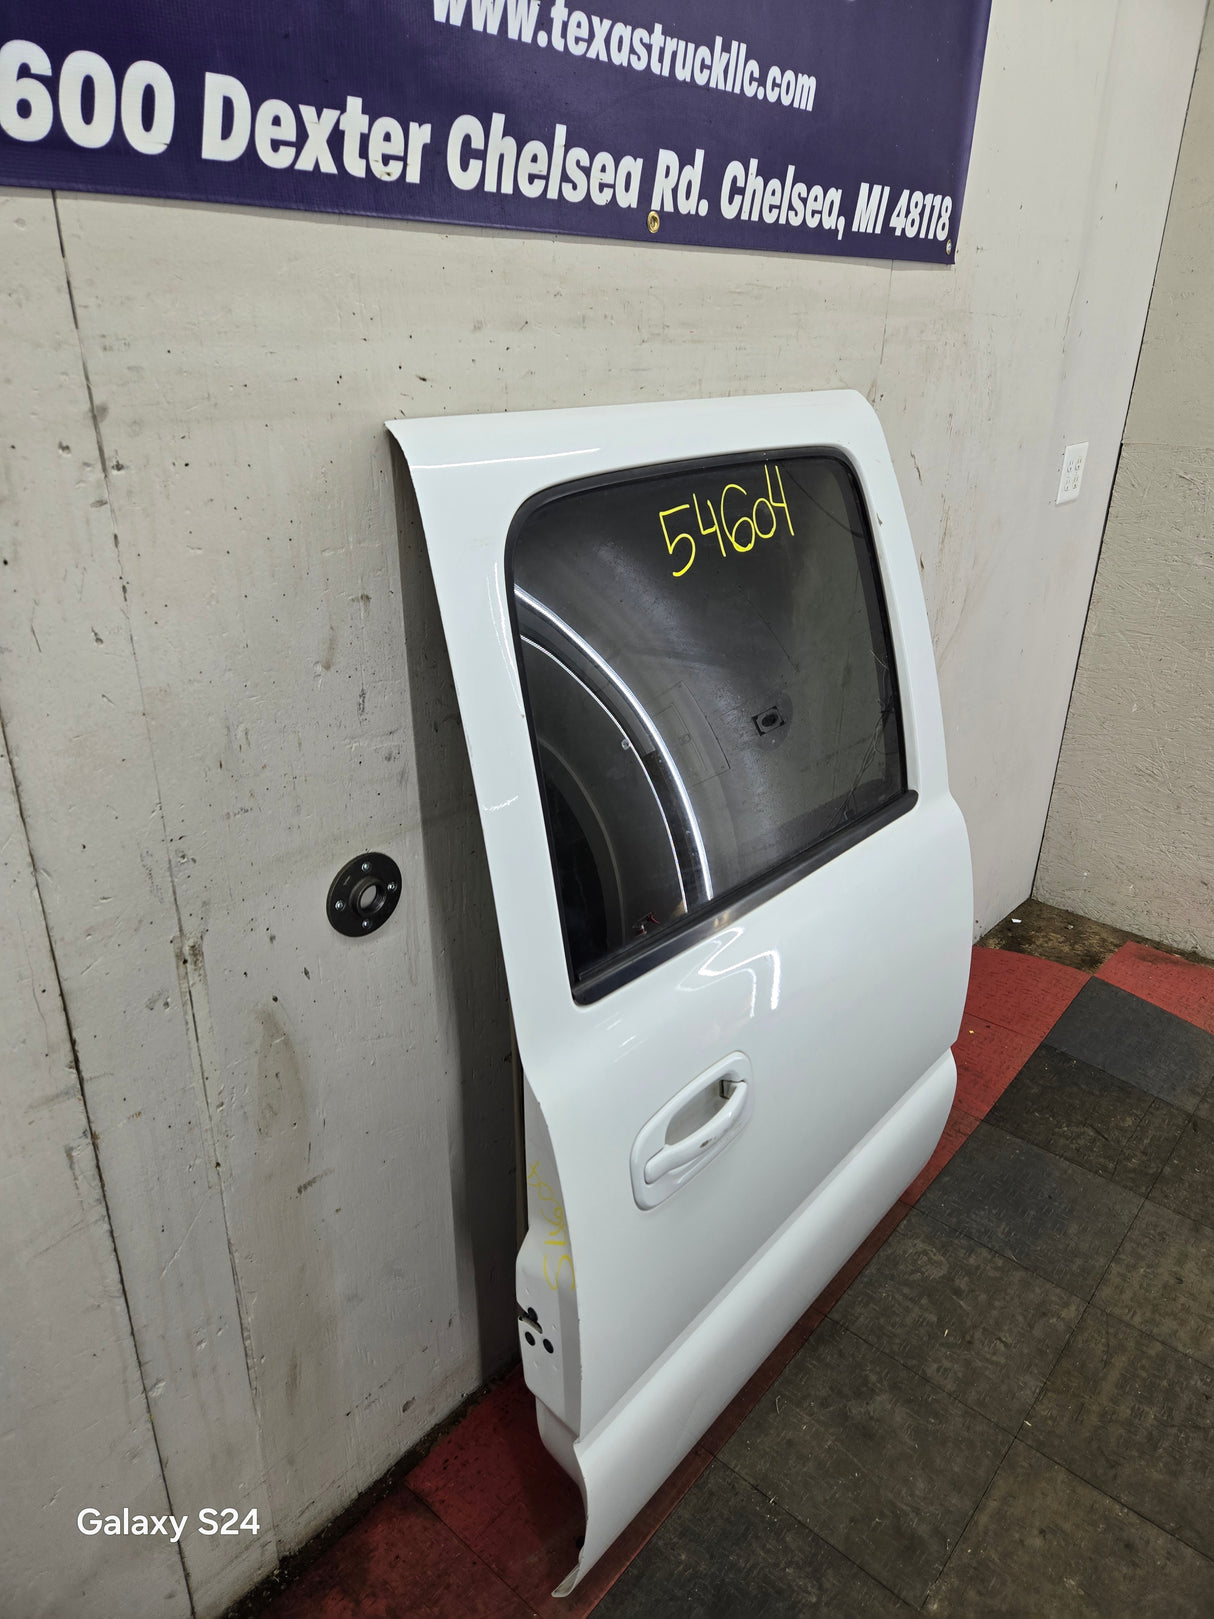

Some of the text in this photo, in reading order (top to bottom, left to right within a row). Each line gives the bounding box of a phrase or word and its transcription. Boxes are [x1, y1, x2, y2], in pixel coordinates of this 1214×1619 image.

[0, 39, 953, 242] 600 Dexter Chelsea Rd. Chelsea, MI 48118
[658, 463, 795, 578] 54604
